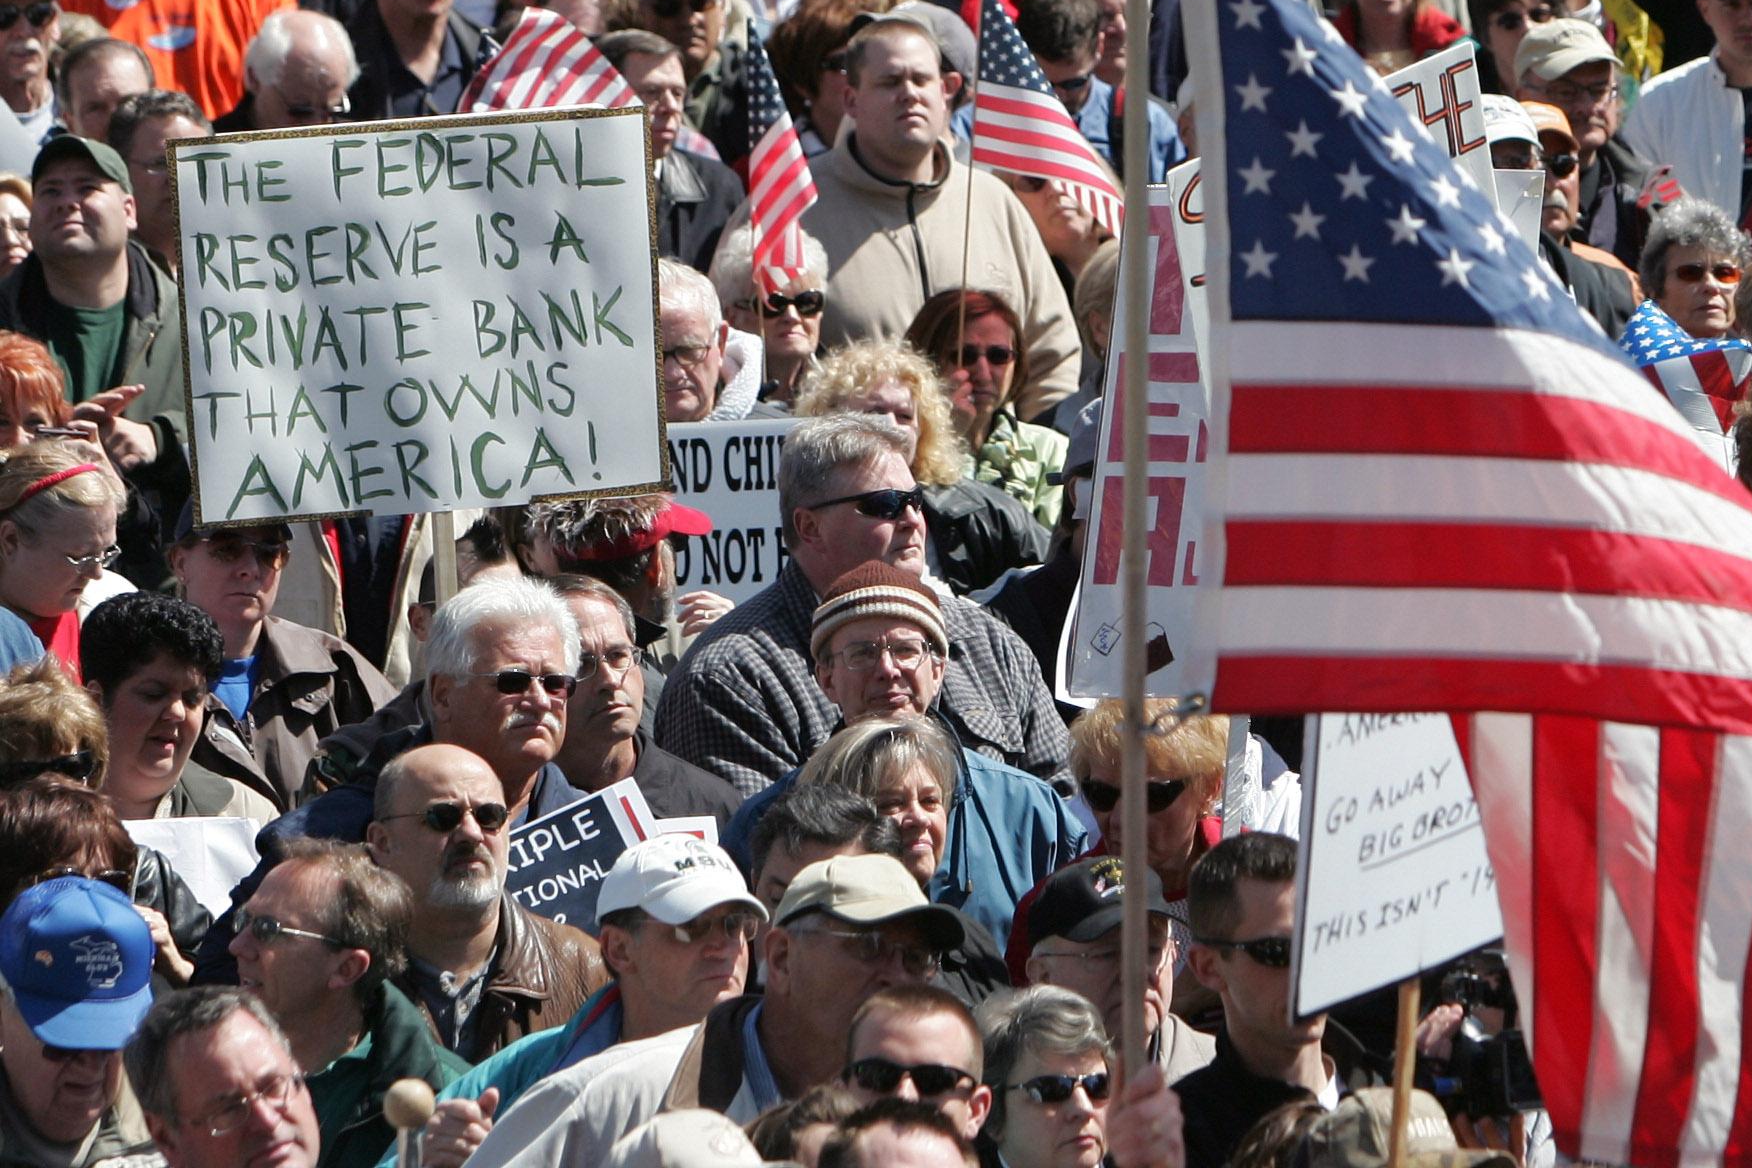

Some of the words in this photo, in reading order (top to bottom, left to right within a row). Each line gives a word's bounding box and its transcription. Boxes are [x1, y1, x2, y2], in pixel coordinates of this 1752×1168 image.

[176, 150, 294, 209] THE
[331, 125, 626, 204] FEDERAL
[191, 218, 445, 295] RESERVE
[474, 212, 521, 271] IS
[545, 209, 592, 269] A
[199, 296, 433, 379] PRIVATE
[472, 283, 636, 360] BANK
[192, 380, 367, 444] THAT
[382, 358, 578, 429] OWNS
[226, 418, 603, 522] AMERICA!
[700, 527, 766, 587] NOT
[1324, 795, 1359, 835] GO
[1367, 755, 1453, 816] AWAY
[1357, 821, 1403, 865] BIG
[1312, 909, 1368, 955] THIS
[1374, 877, 1451, 931] ISN'T
